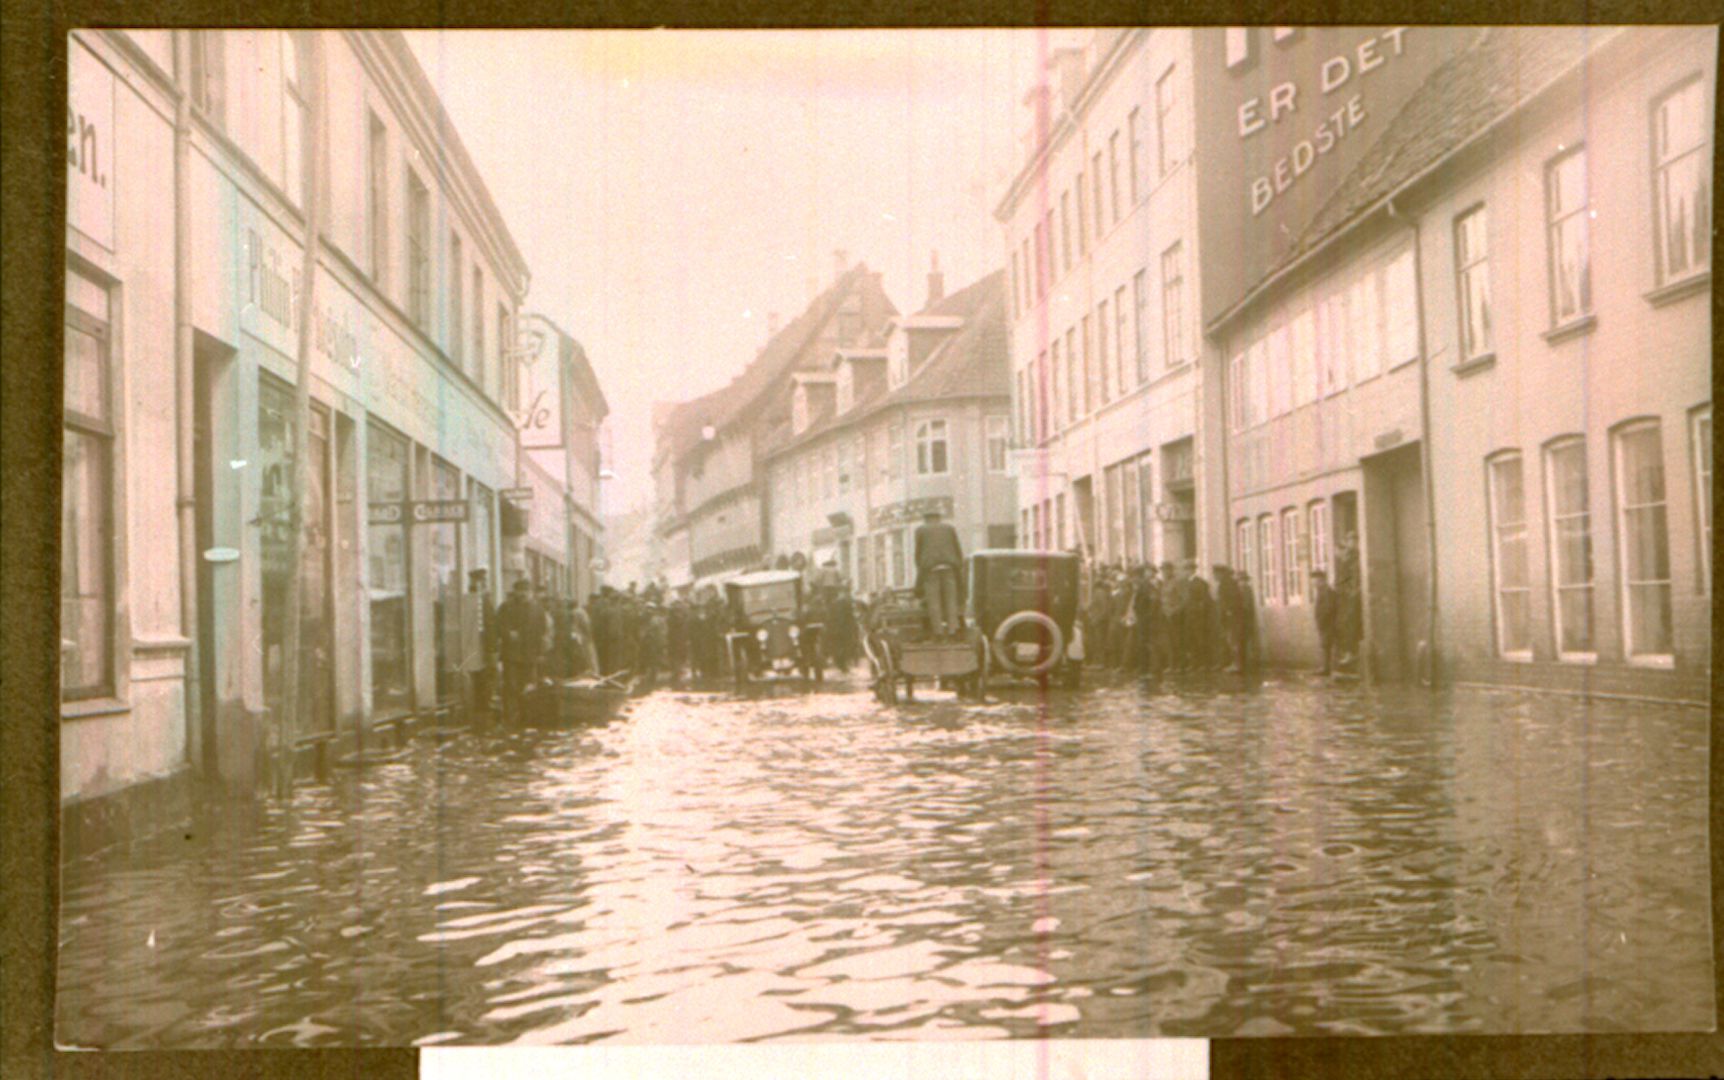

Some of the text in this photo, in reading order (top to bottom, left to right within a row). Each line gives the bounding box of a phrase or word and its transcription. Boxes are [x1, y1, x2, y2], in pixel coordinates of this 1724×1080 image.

[1238, 81, 1297, 137] ER
[1321, 28, 1408, 94] DET
[1252, 94, 1367, 216] BEDSTE
